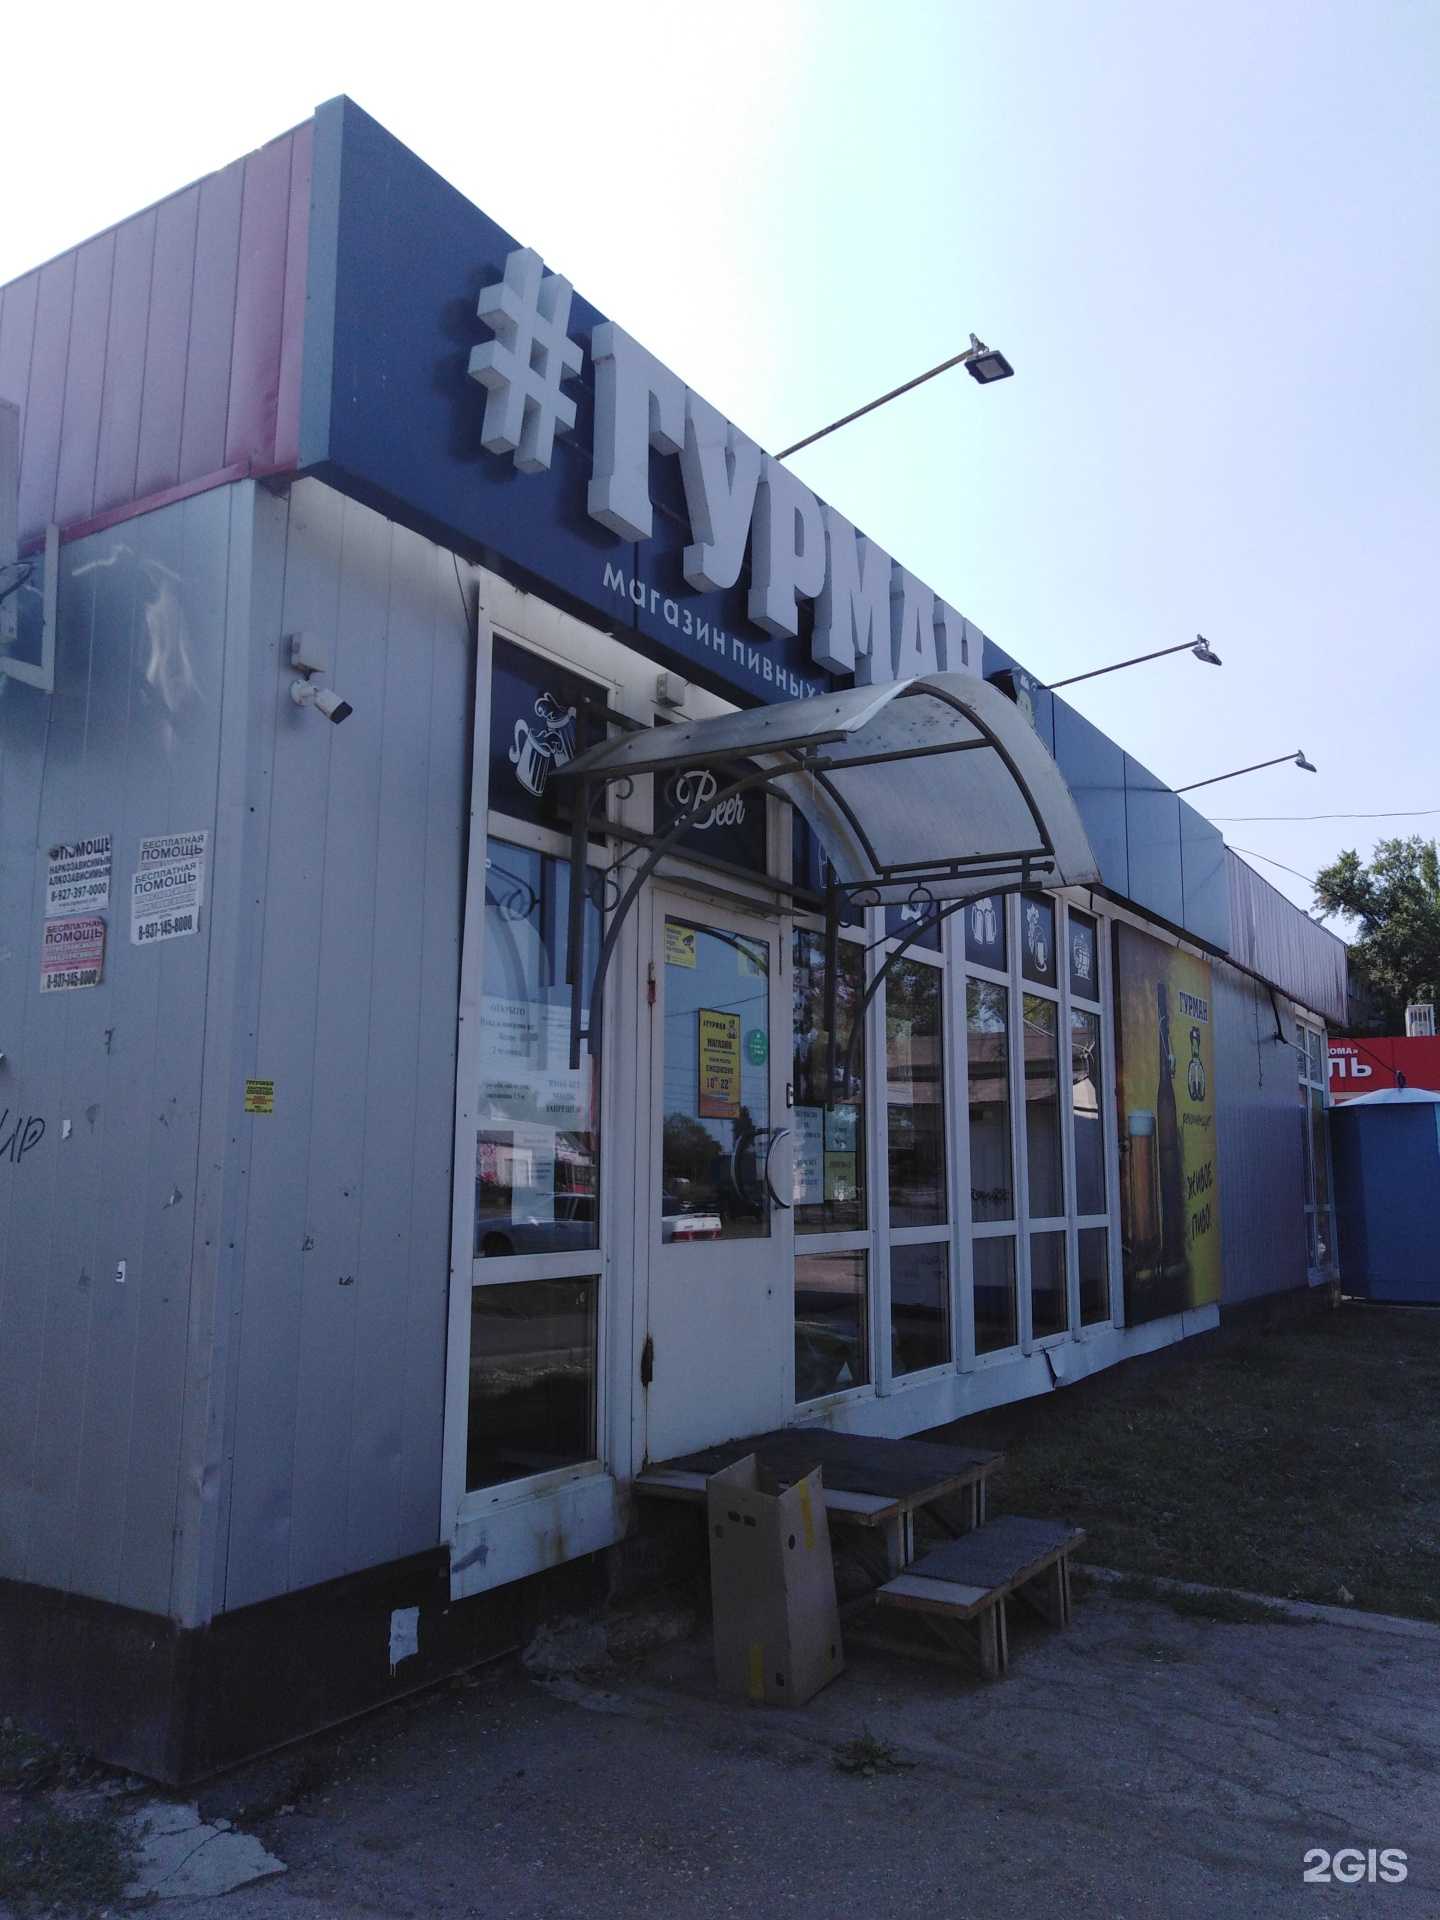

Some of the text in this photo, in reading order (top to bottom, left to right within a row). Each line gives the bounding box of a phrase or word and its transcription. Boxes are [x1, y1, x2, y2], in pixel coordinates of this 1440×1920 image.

[602, 562, 816, 699] магазин пивных
[143, 834, 205, 849] БЕСПЛАТНАЯ
[141, 845, 203, 861] ПОМОЩЬ
[135, 863, 196, 883] БЕСПЛАТНАЯ
[134, 873, 197, 894] ПОМОЩЬ
[45, 928, 103, 945] ПОМОЩЬ
[1179, 991, 1208, 1021] ГУРМАН
